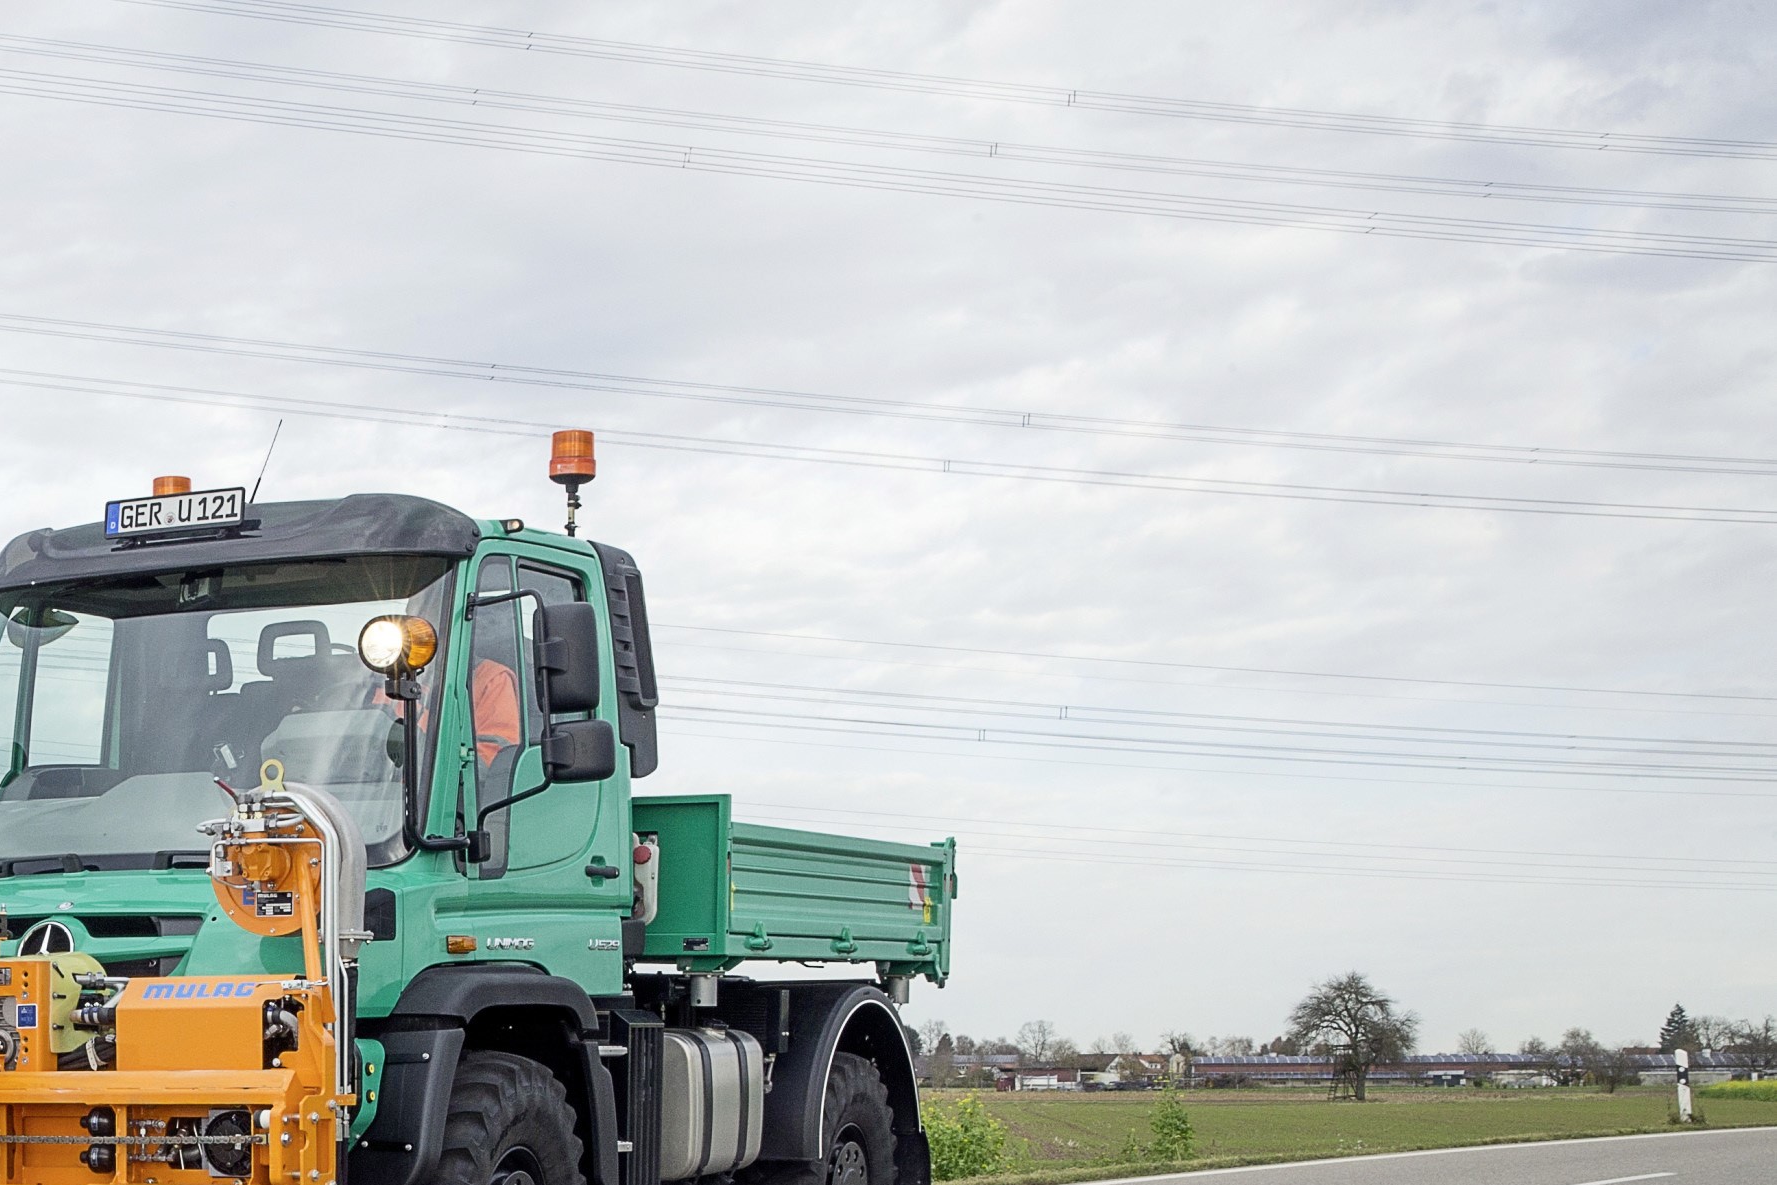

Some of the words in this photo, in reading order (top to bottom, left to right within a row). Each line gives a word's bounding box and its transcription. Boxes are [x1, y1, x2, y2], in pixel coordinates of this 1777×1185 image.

[121, 502, 162, 529] GER
[178, 498, 192, 522] U
[197, 494, 238, 521] 121
[486, 937, 534, 950] UNIMOG
[142, 982, 255, 999] MULAG
